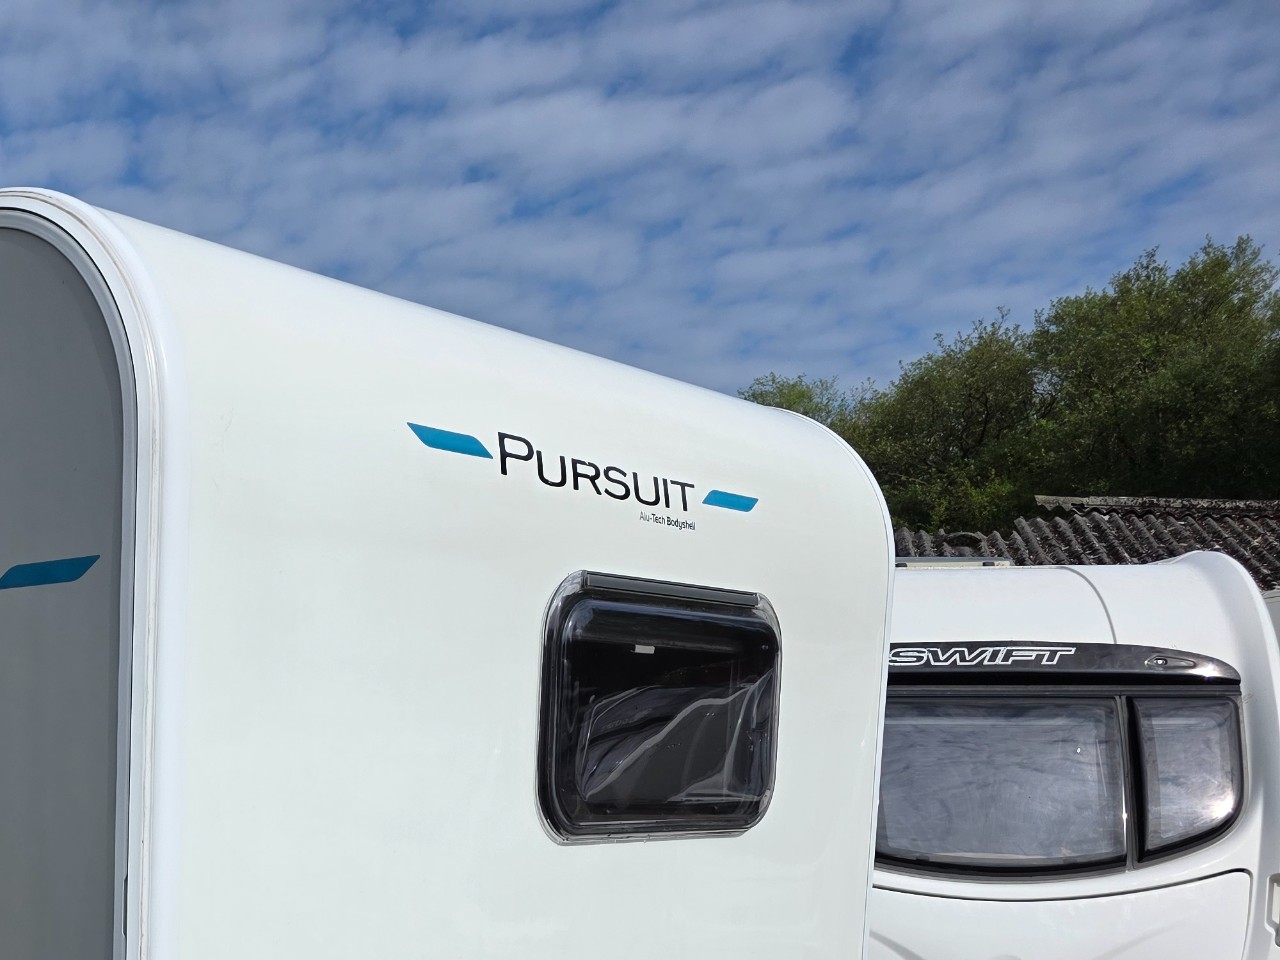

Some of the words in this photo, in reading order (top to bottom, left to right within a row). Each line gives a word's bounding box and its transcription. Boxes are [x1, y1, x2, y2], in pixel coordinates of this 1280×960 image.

[497, 431, 695, 512] PURSUIT
[666, 516, 696, 531] Bodyshell
[888, 647, 1077, 666] SWIFT
